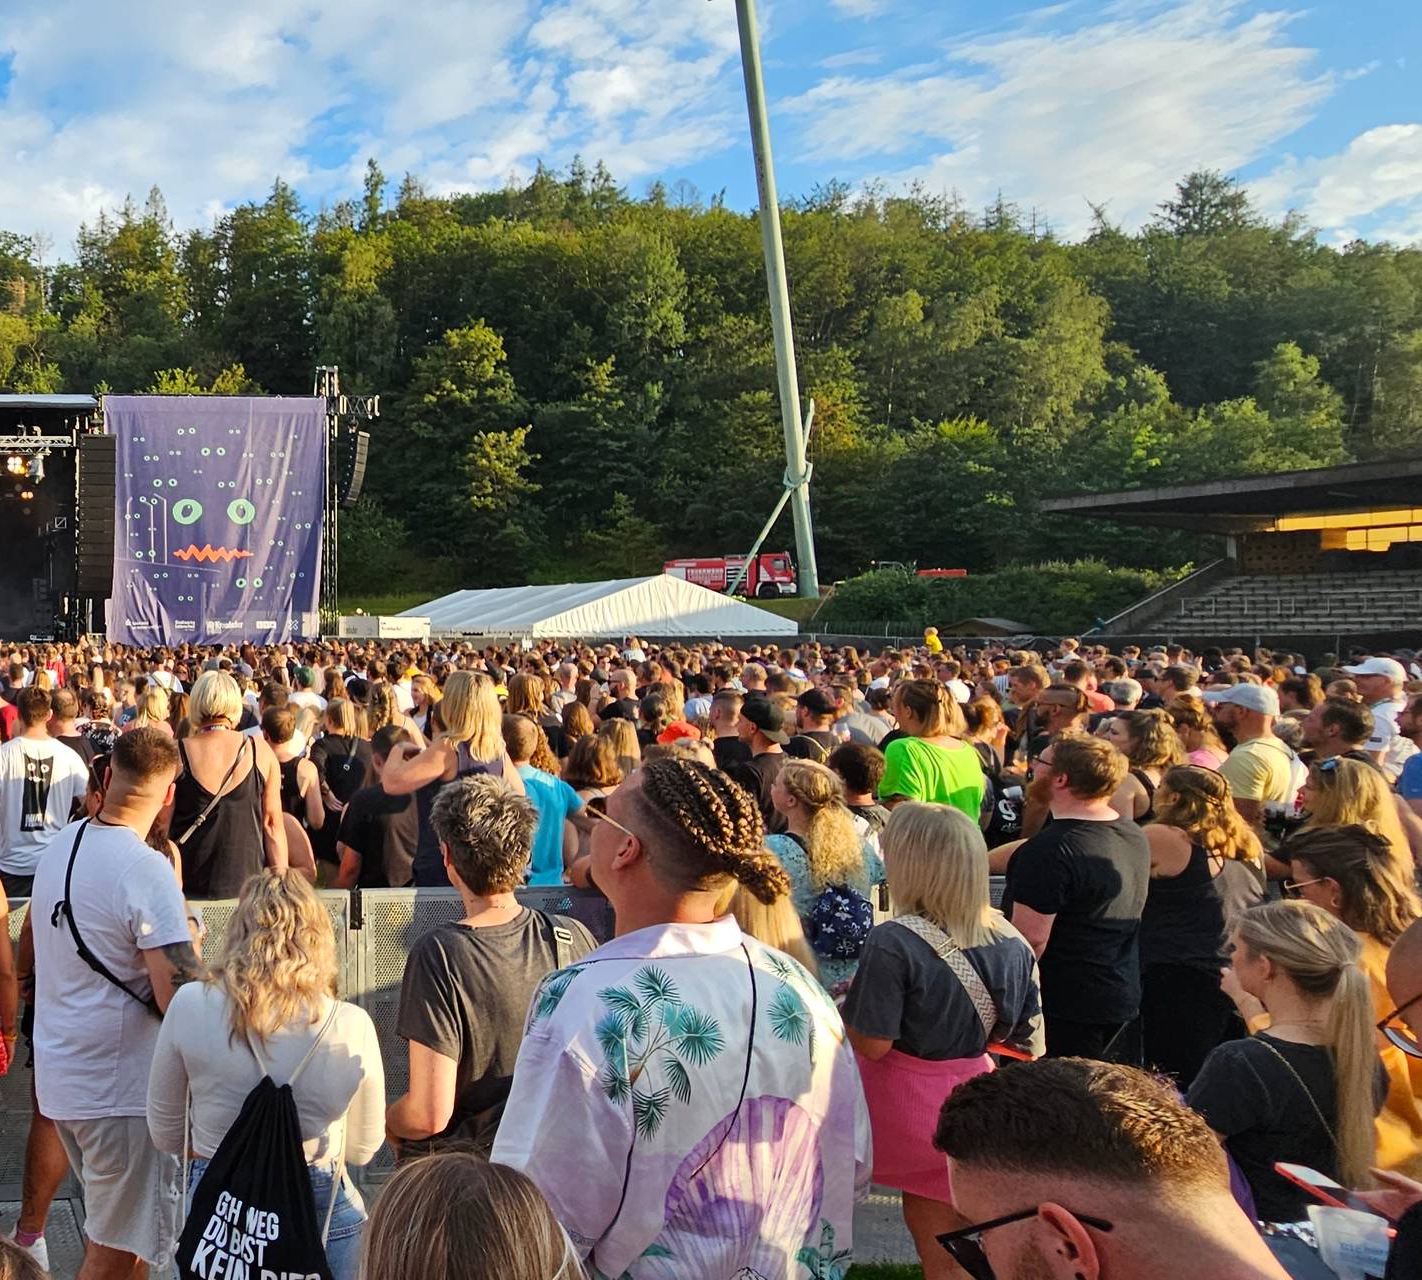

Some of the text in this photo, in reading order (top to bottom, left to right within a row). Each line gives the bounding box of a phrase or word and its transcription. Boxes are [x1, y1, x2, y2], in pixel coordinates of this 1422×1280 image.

[202, 1214, 268, 1267] DU BIST
[245, 1206, 279, 1241] WEG
